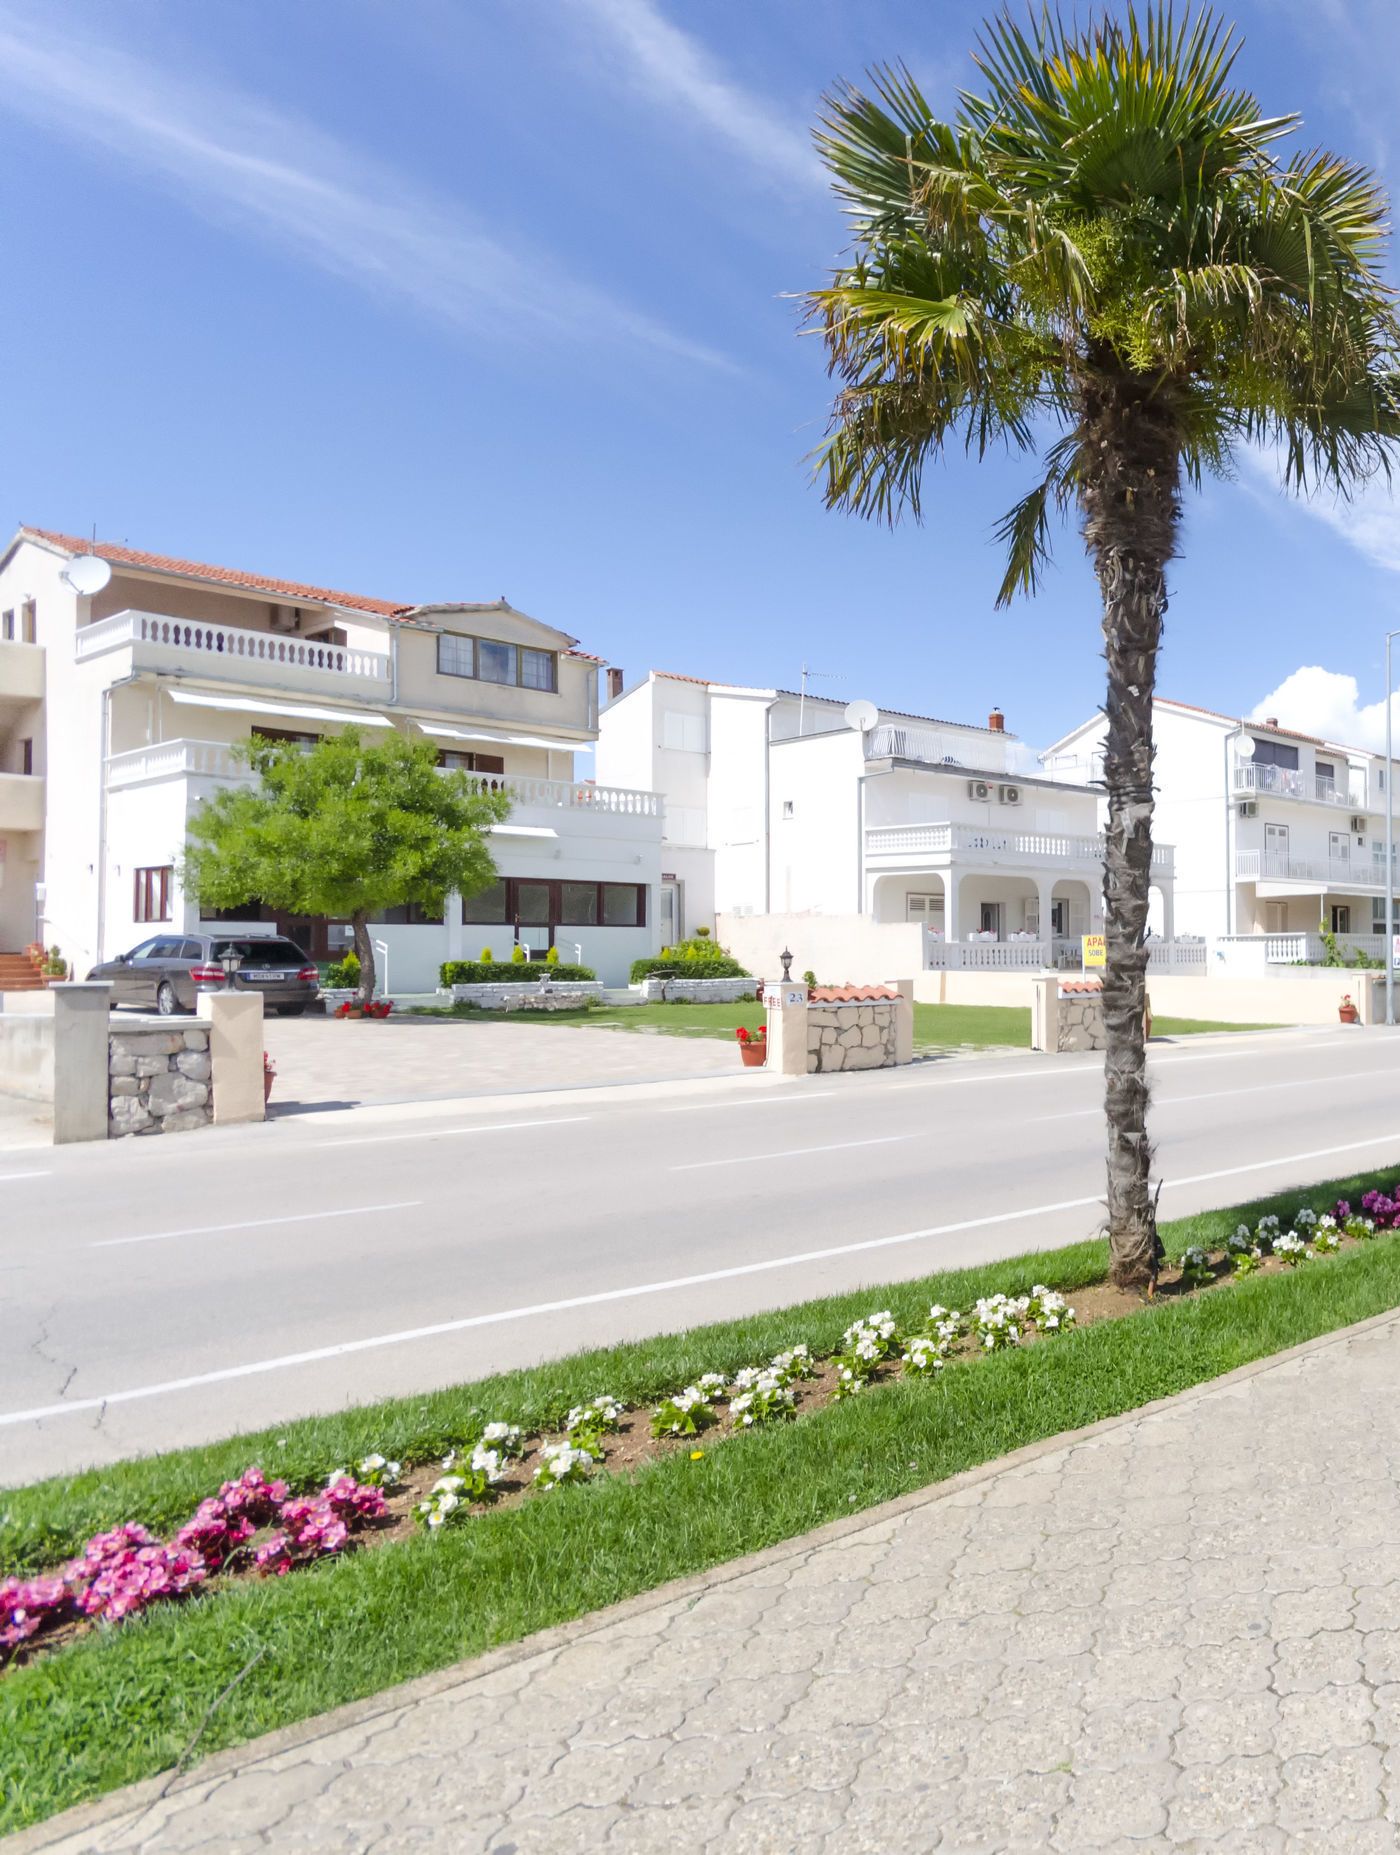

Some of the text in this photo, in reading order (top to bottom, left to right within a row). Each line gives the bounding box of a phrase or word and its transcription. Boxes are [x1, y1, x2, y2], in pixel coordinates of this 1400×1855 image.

[1088, 949, 1103, 957] SOBE
[763, 996, 781, 1007] FREE
[789, 993, 803, 1003] 23
